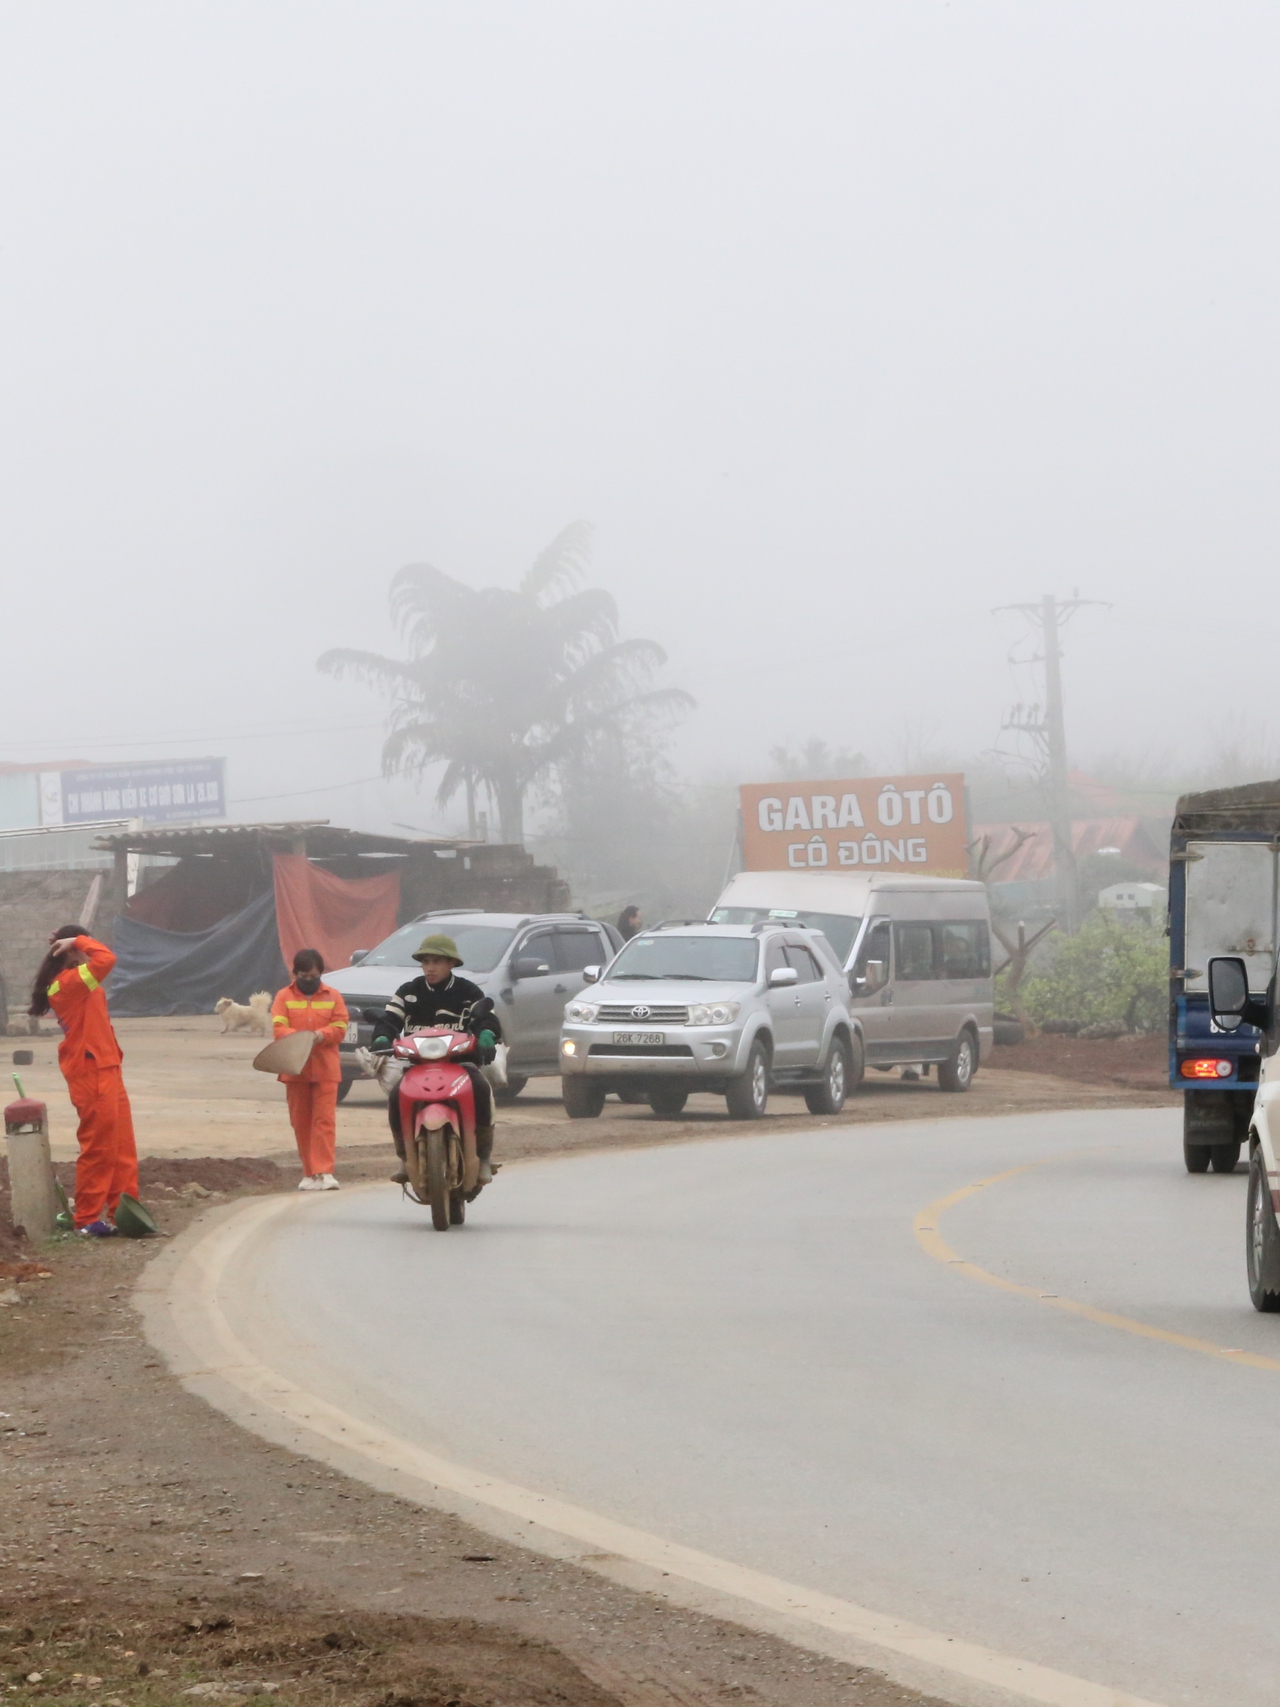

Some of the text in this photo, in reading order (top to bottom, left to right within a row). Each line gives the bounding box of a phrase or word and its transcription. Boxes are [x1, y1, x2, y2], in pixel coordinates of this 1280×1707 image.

[758, 782, 953, 832] GARA ÔTÔ
[788, 832, 927, 868] CÔ ĐÔNG
[616, 1033, 661, 1044] 26K-7268
